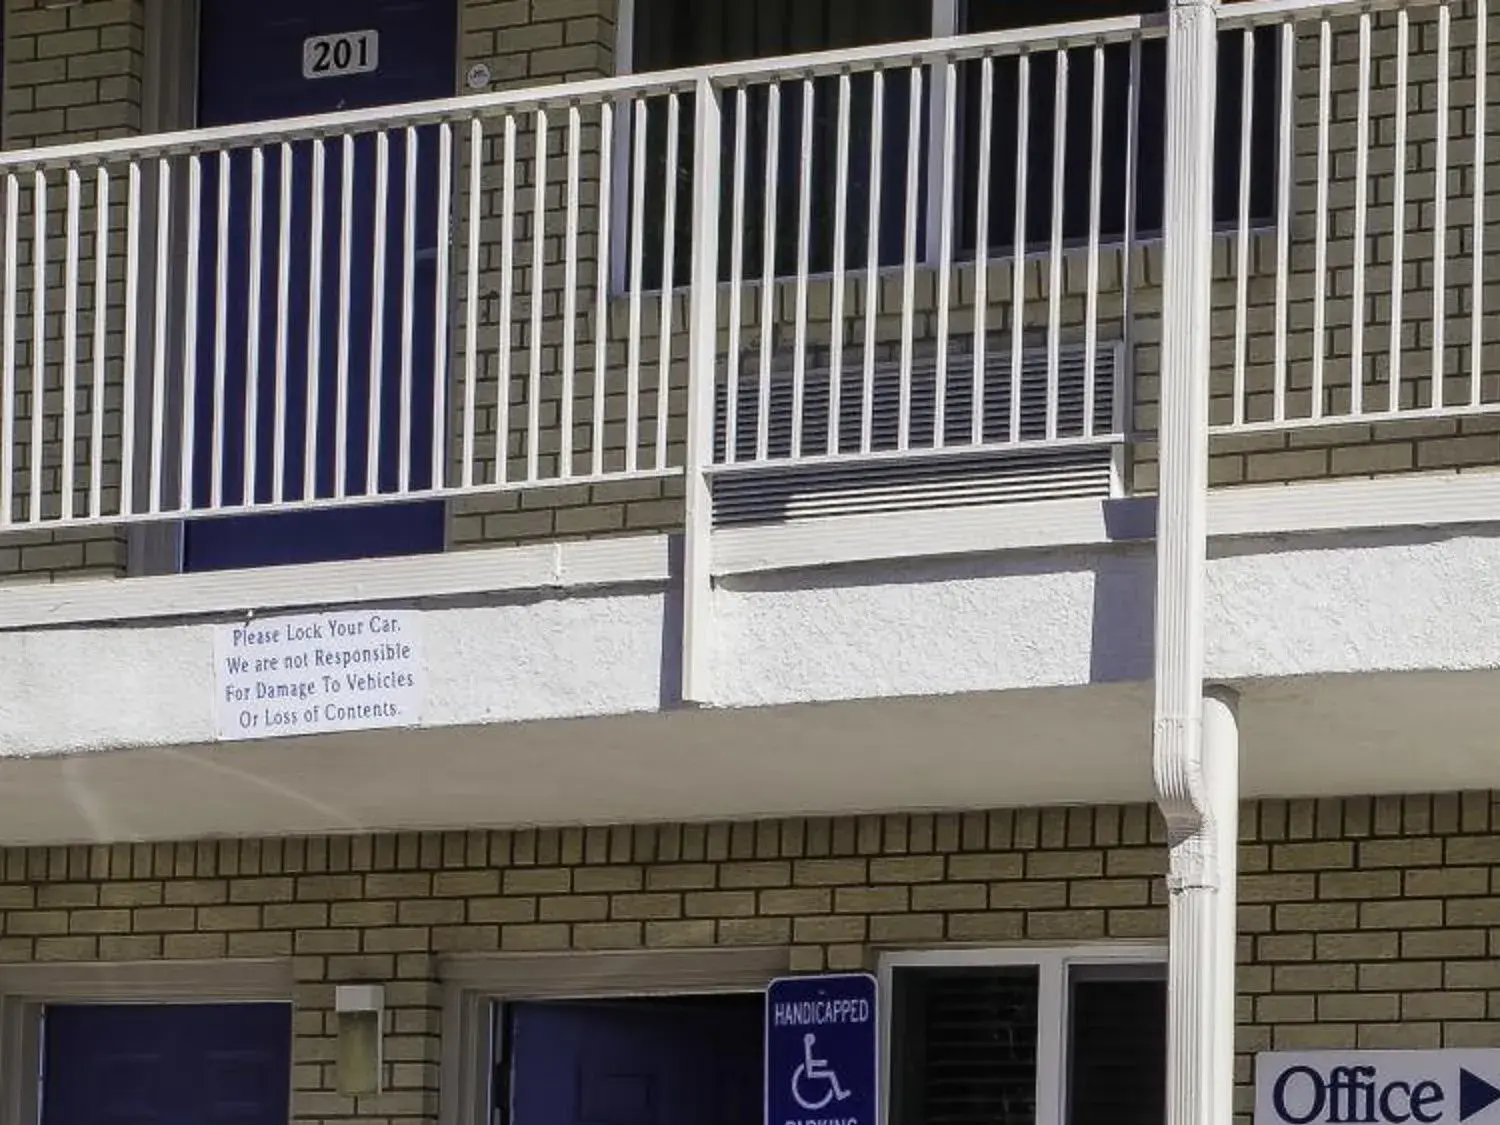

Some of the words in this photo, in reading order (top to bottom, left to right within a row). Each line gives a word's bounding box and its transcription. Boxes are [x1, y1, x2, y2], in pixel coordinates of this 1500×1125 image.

[312, 36, 368, 72] 201
[233, 628, 280, 647] Please
[287, 621, 323, 640] Lock
[328, 616, 363, 637] Your
[370, 615, 401, 633] Car.
[226, 655, 249, 674] We
[255, 655, 278, 673] are
[285, 652, 309, 670] not
[314, 643, 411, 669] Responsible
[226, 684, 250, 702] For
[256, 679, 316, 700] Damage
[322, 675, 341, 693] To
[347, 671, 415, 692] Vehicles
[239, 710, 259, 728] Or
[265, 707, 298, 726] Loss
[304, 705, 320, 722] of
[325, 702, 401, 721] Contents.
[774, 999, 870, 1026] HANDICAPPED
[1272, 1065, 1445, 1125] Office
